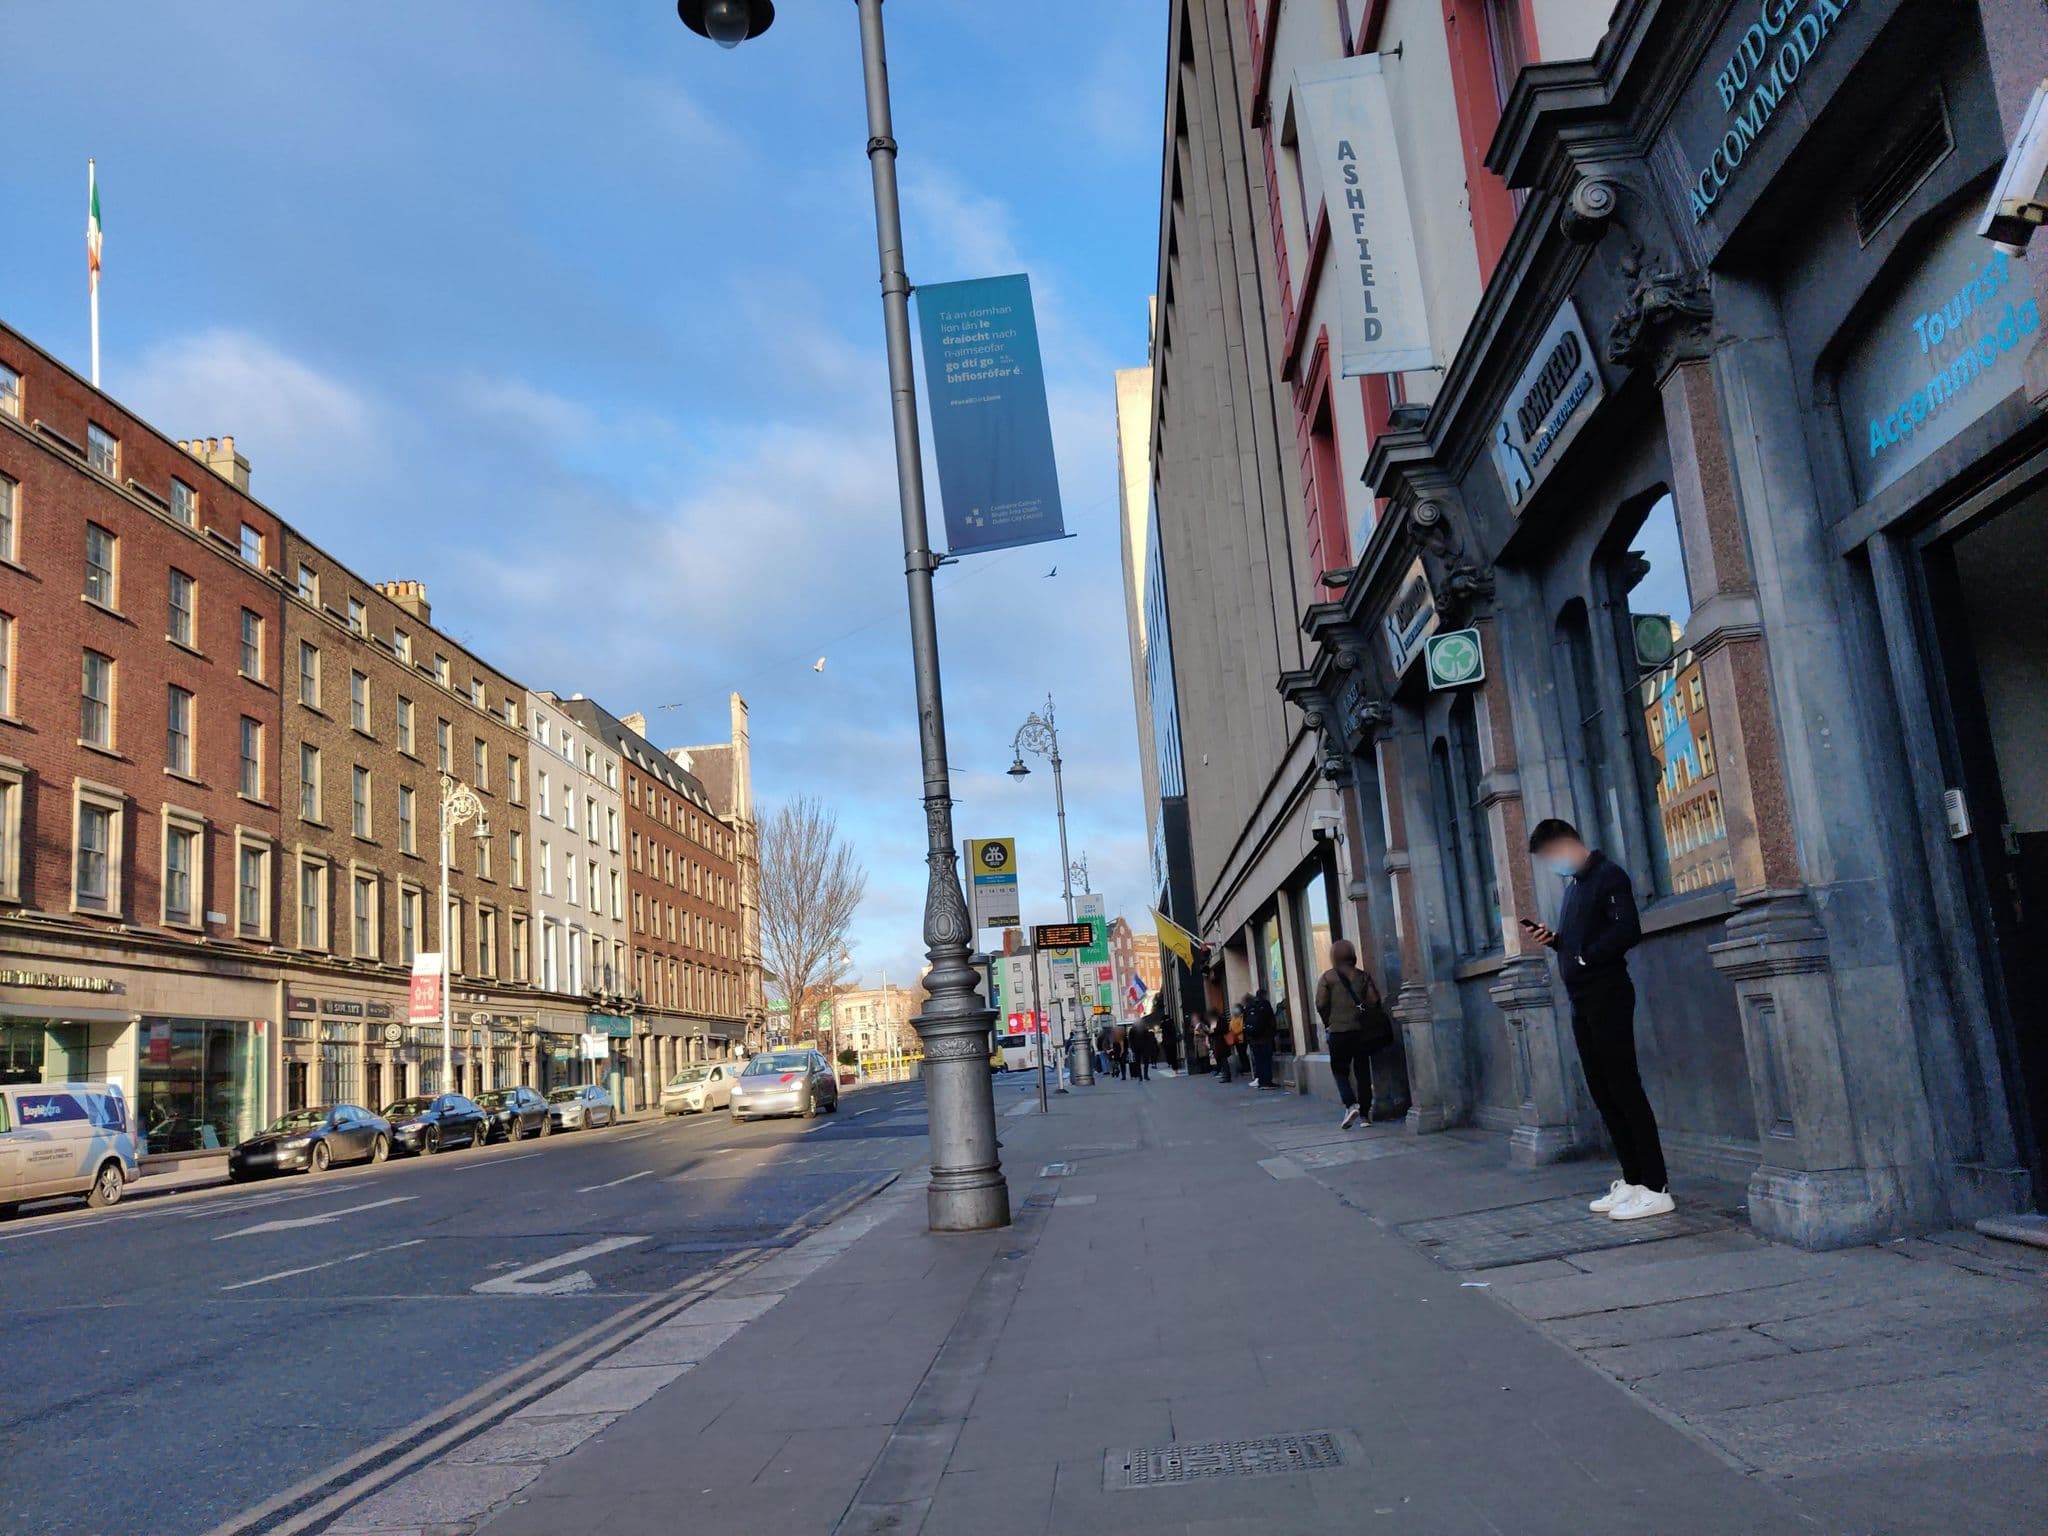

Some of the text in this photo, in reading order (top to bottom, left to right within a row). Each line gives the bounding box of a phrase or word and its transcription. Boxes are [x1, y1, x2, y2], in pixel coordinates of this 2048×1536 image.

[1689, 0, 1850, 225] ACCOMMODA
[1337, 140, 1383, 343] ASHFIELD
[954, 311, 967, 320] an
[969, 304, 1012, 318] domhan
[980, 319, 990, 329] le
[1912, 250, 2010, 354] Tourist
[992, 328, 1017, 339] nach
[946, 362, 960, 373] go
[980, 358, 994, 369] go
[1517, 331, 1582, 444] ASHFIELD
